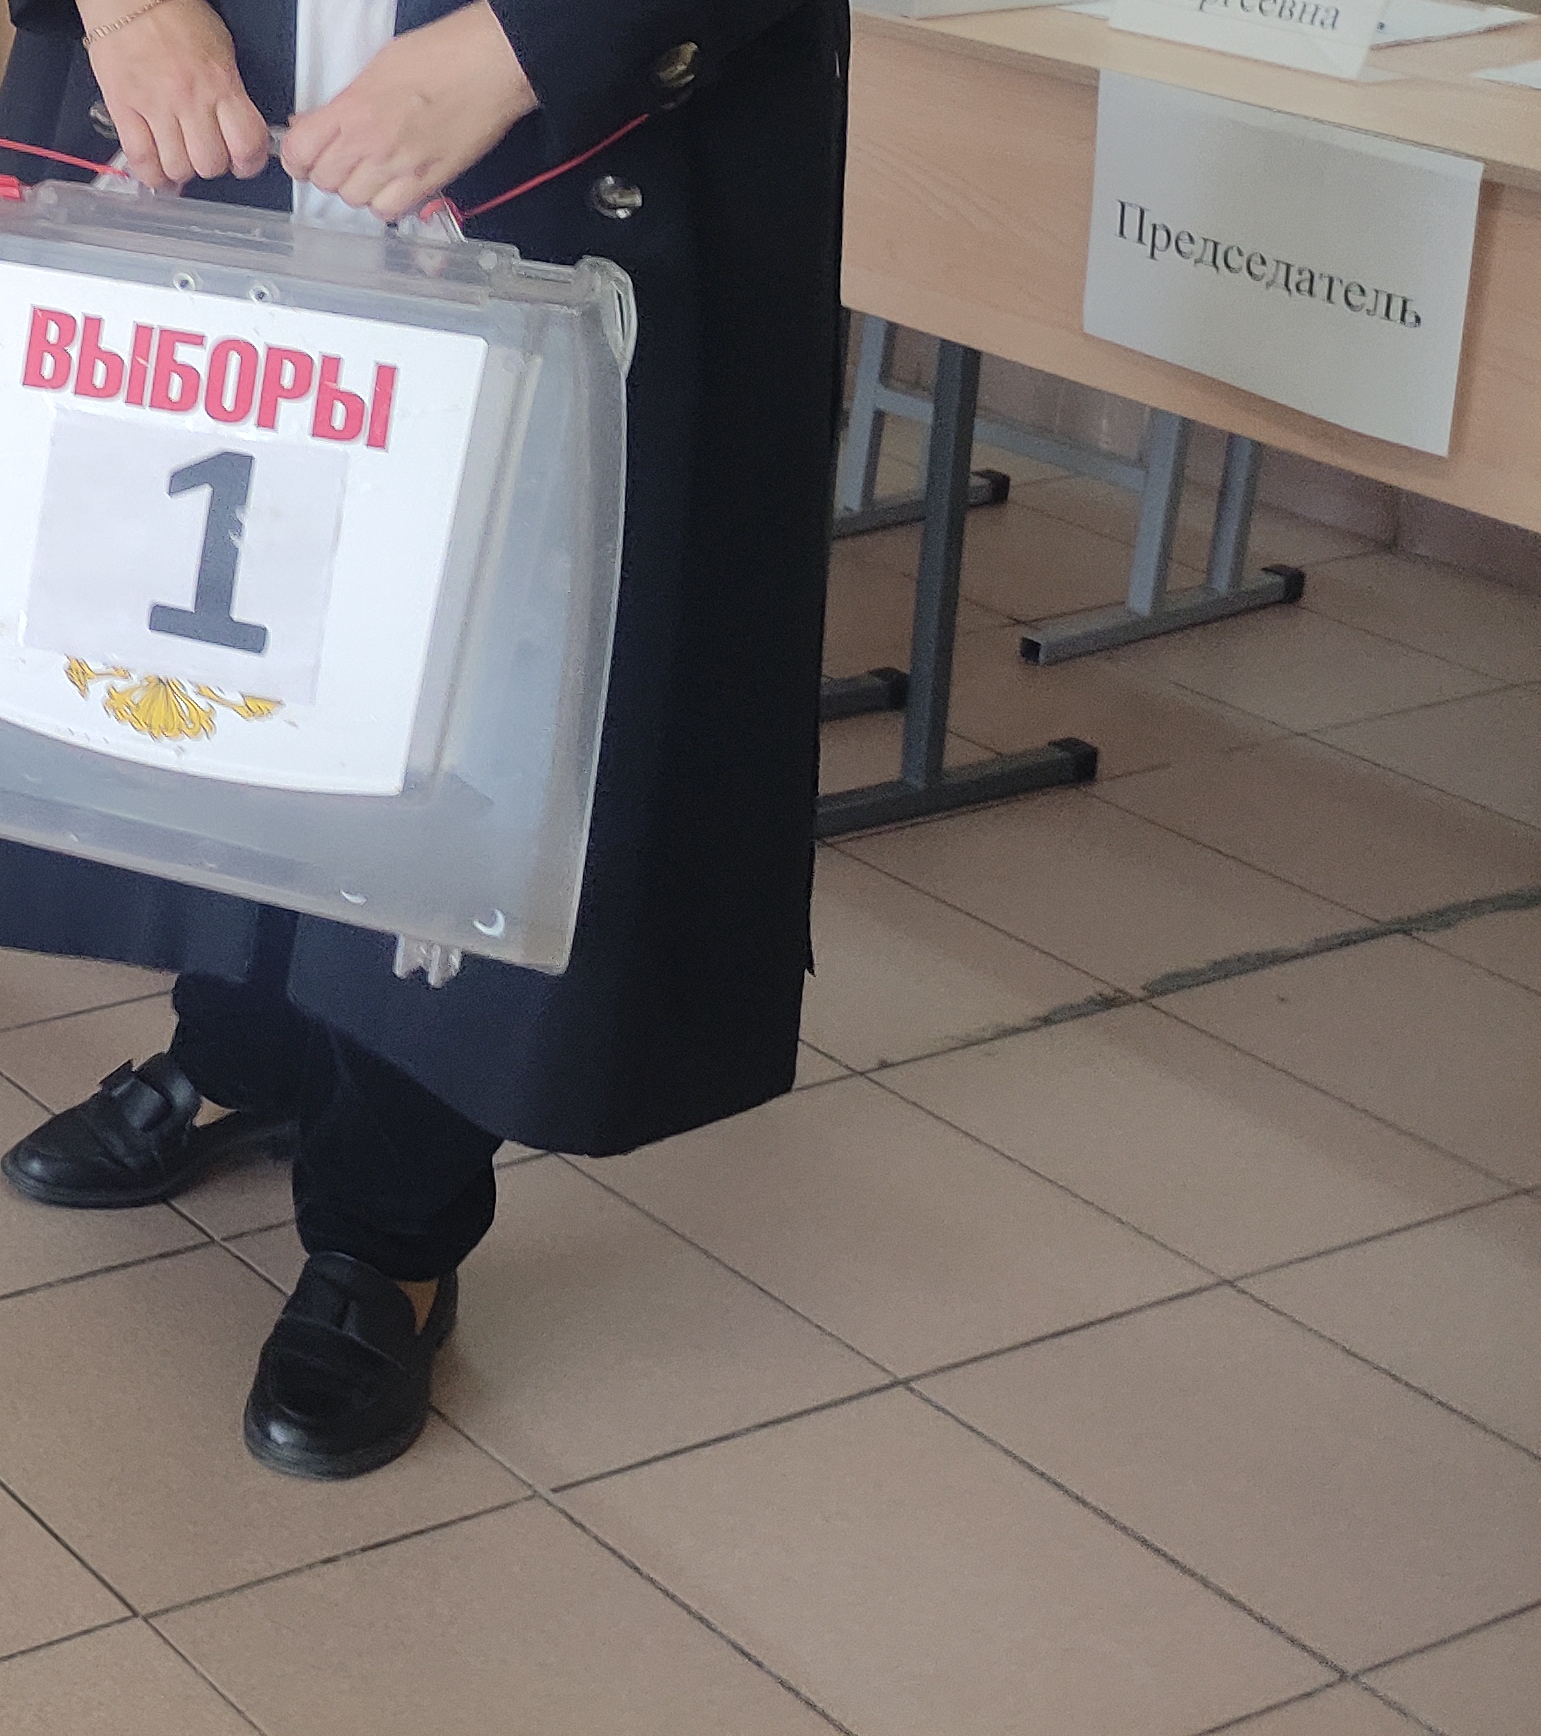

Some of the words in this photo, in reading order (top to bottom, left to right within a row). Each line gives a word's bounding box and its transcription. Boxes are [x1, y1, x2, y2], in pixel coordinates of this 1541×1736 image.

[1115, 198, 1423, 331] Председатель
[21, 304, 400, 453] ВЫБОРЫ
[147, 448, 270, 656] 1
